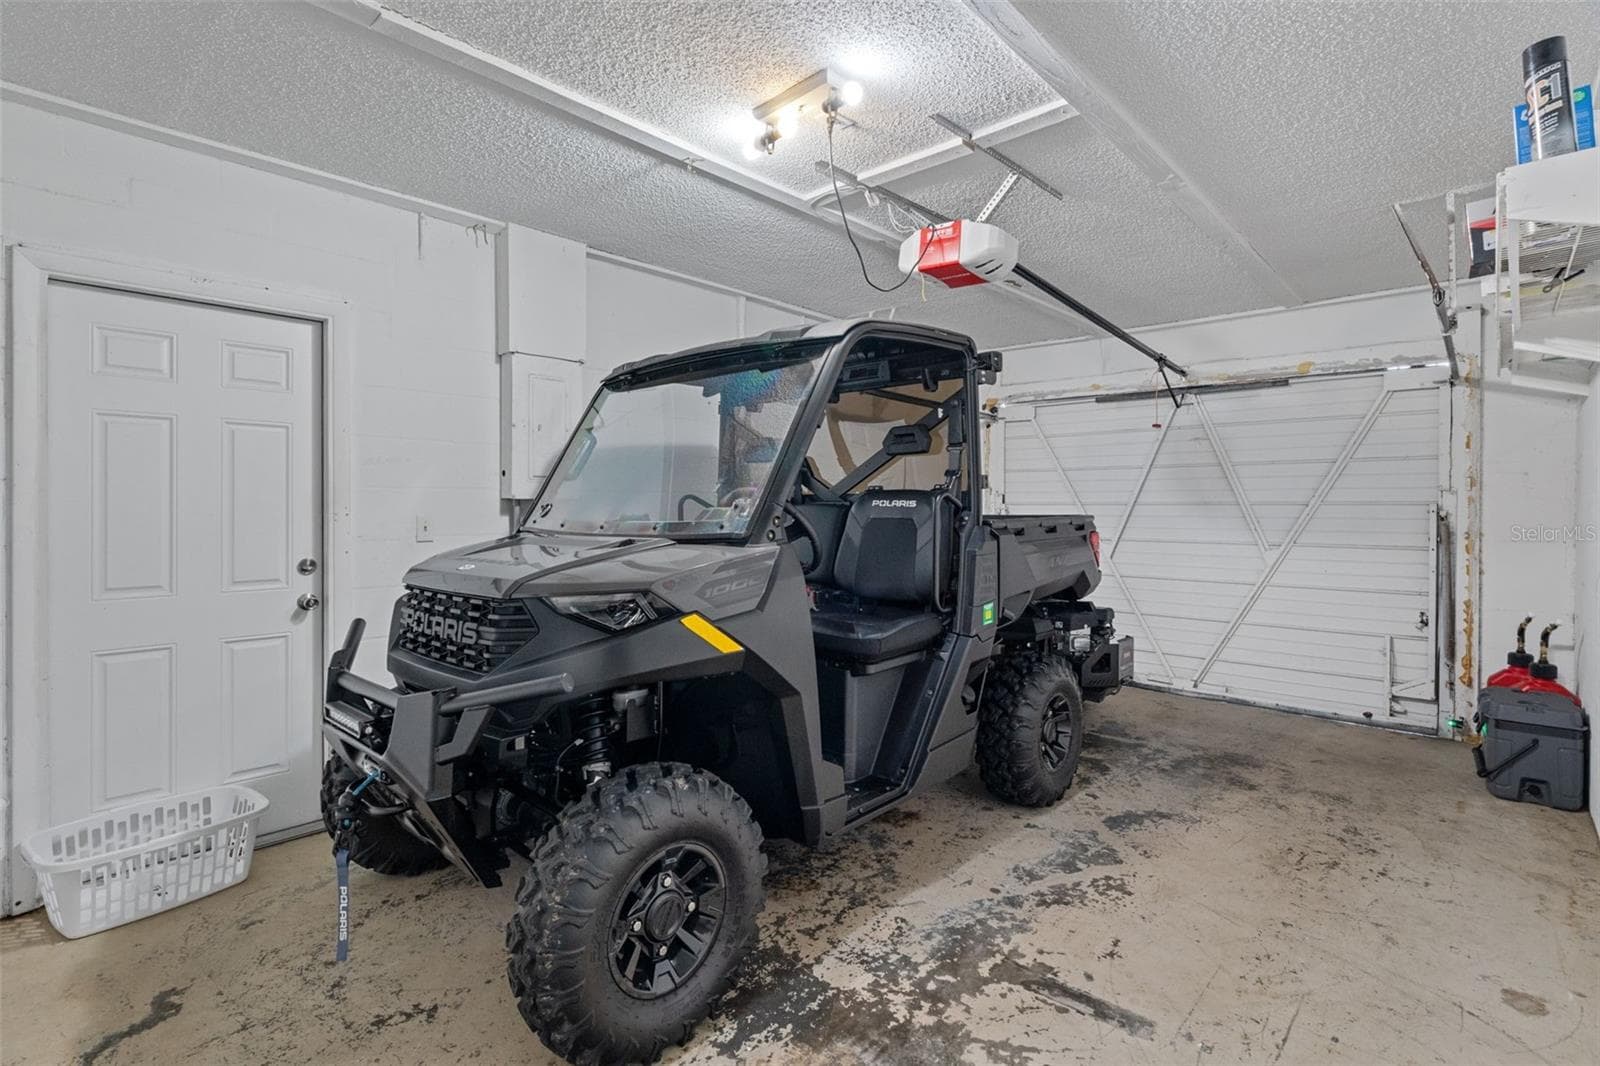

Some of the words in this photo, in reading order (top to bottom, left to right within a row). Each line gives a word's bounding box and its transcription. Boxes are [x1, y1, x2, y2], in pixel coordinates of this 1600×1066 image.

[871, 499, 917, 508] POLARIS
[401, 607, 478, 645] POLARIS
[339, 886, 348, 941] POLARIS
